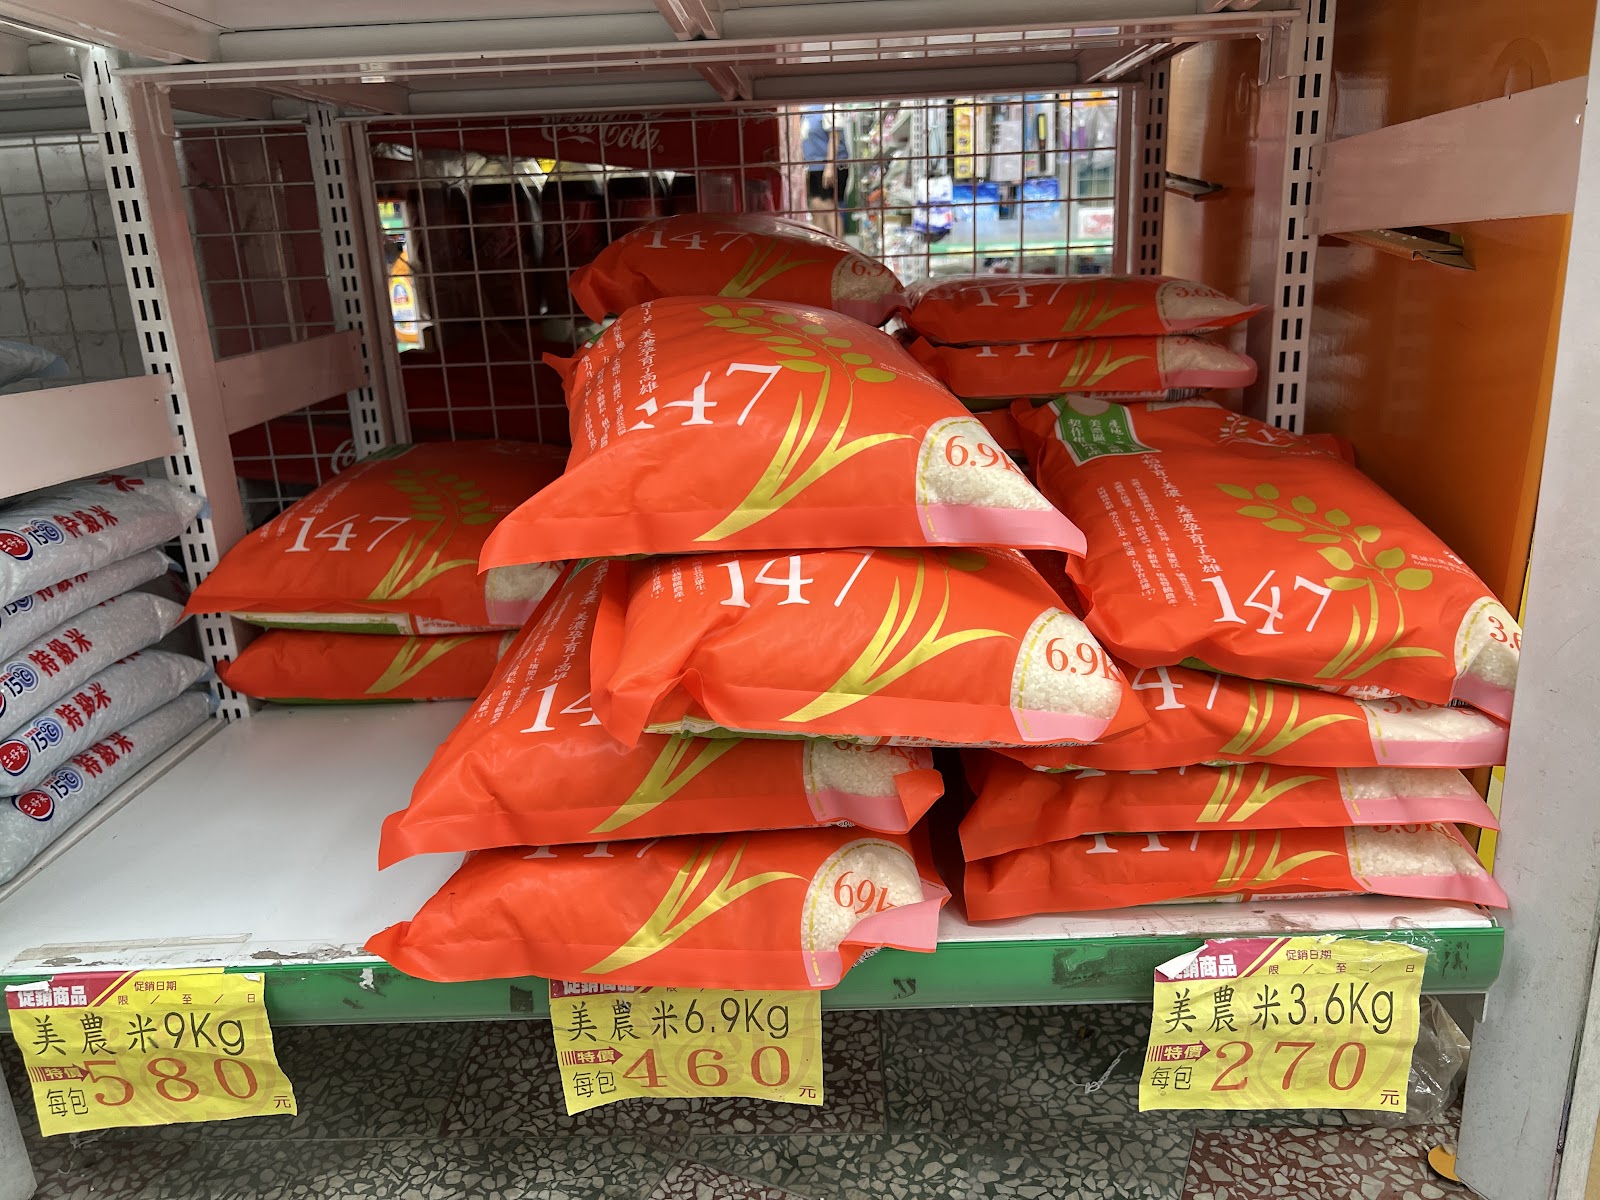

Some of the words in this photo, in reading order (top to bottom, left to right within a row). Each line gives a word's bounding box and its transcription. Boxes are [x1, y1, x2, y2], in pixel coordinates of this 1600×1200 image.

[643, 230, 749, 252] 147
[625, 363, 782, 433] 147
[285, 514, 413, 553] 147
[1201, 569, 1333, 635] 147
[28, 628, 93, 678] 特級米
[55, 681, 112, 733] 特級米
[72, 731, 135, 779] 特級米
[1268, 965, 1279, 976] 限
[1336, 962, 1347, 974] 至
[1286, 949, 1332, 961] 促銷日期
[17, 985, 88, 1008] 促銷商品
[117, 994, 129, 1006] 限
[182, 993, 193, 1005] 至
[247, 993, 256, 1004] 日
[134, 980, 177, 993] 促銷日期
[577, 1050, 615, 1063] 特價
[622, 1046, 790, 1088] 460
[1163, 1046, 1203, 1061] 特價
[1211, 1041, 1367, 1092] 270
[45, 1067, 83, 1080] 特價
[85, 1057, 259, 1106] 580
[572, 1070, 615, 1098] 每包
[799, 1085, 816, 1099] 元
[1151, 1065, 1192, 1091] 每包
[1380, 1089, 1399, 1106] 元
[46, 1087, 89, 1117] 每包
[273, 1095, 291, 1109] 元
